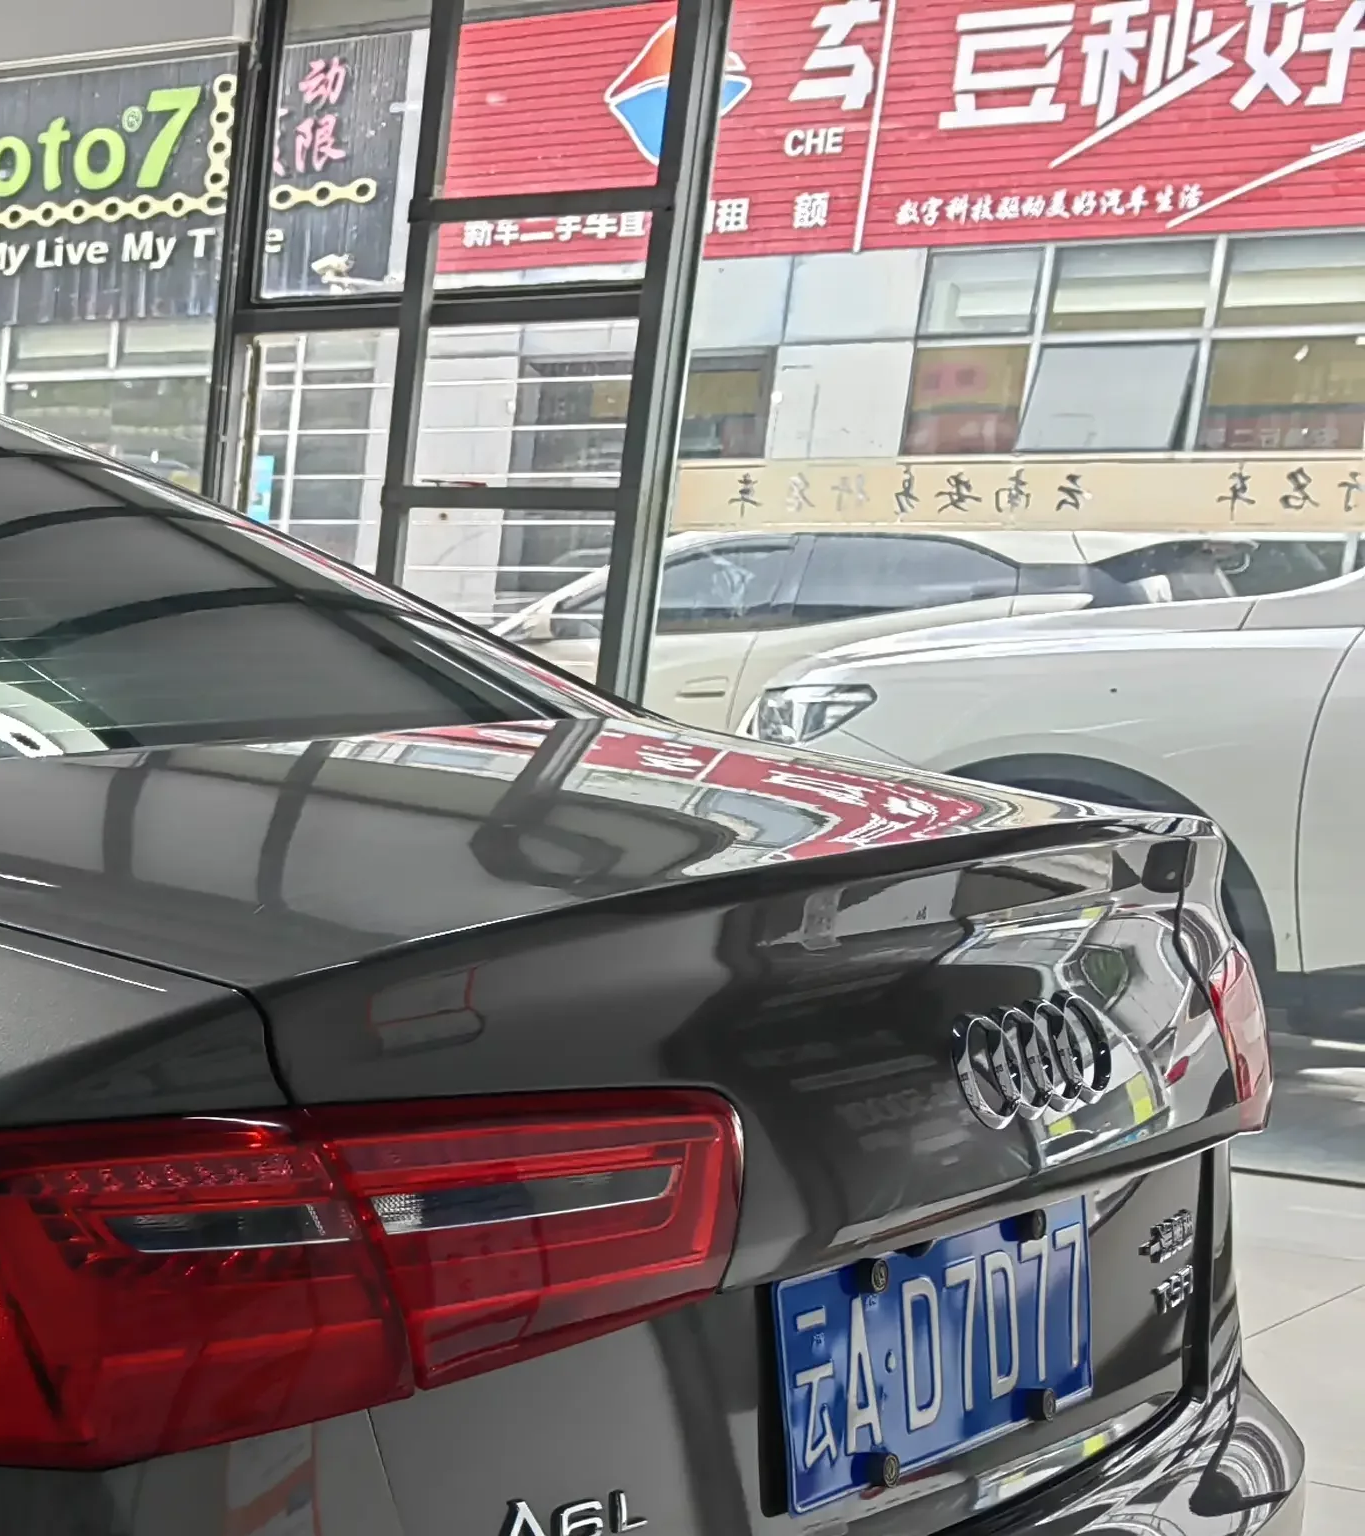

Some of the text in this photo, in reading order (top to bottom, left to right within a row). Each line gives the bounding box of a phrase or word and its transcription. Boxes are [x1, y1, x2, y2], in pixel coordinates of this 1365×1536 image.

[783, 126, 846, 157] CHE
[35, 235, 109, 268] Live
[122, 230, 177, 270] My
[187, 227, 284, 259] Te
